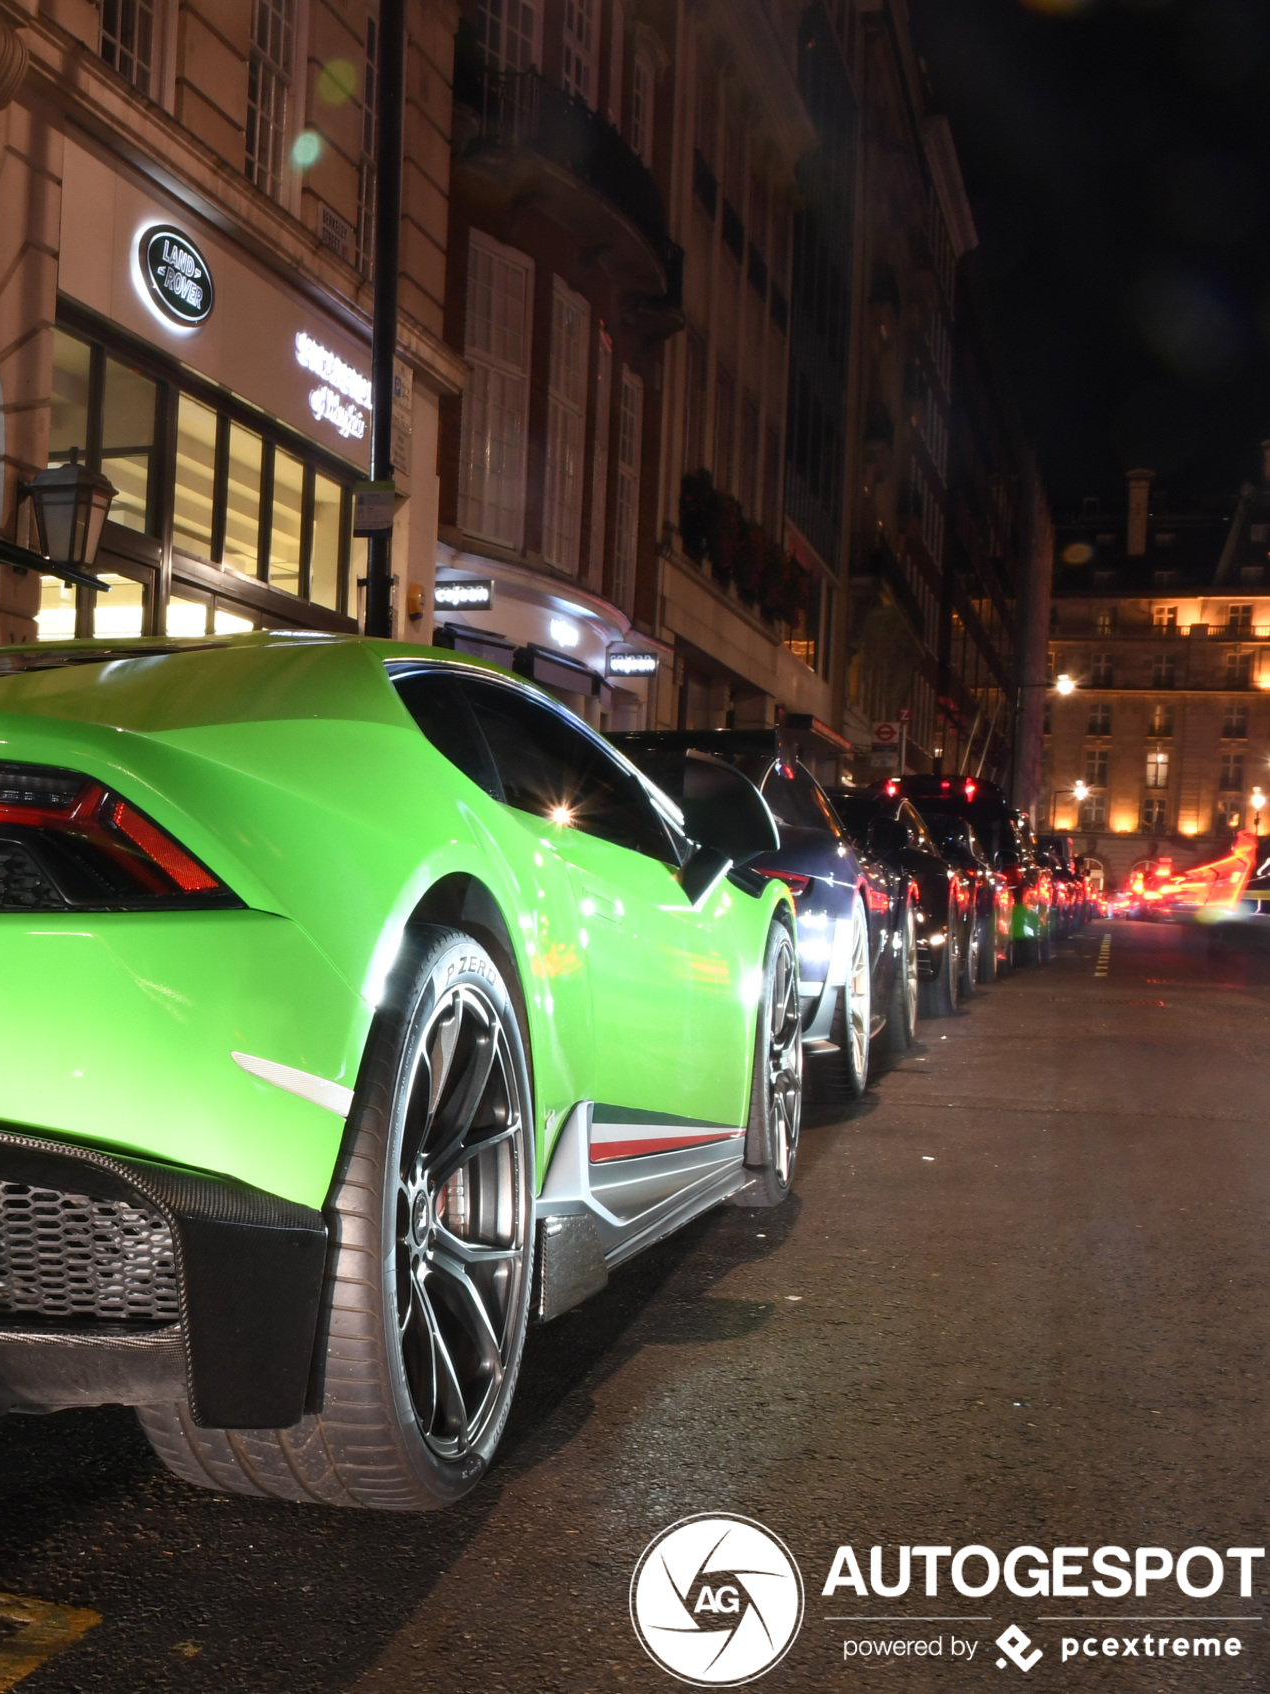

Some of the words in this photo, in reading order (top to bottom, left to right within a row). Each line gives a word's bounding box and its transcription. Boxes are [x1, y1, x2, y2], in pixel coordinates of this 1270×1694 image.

[322, 209, 348, 239] BERKELEY
[322, 227, 341, 251] STREET
[162, 239, 196, 277] LAND
[164, 266, 204, 310] ROVER
[900, 709, 909, 721] Z
[446, 962, 455, 986] P
[458, 956, 497, 987] ZERO
